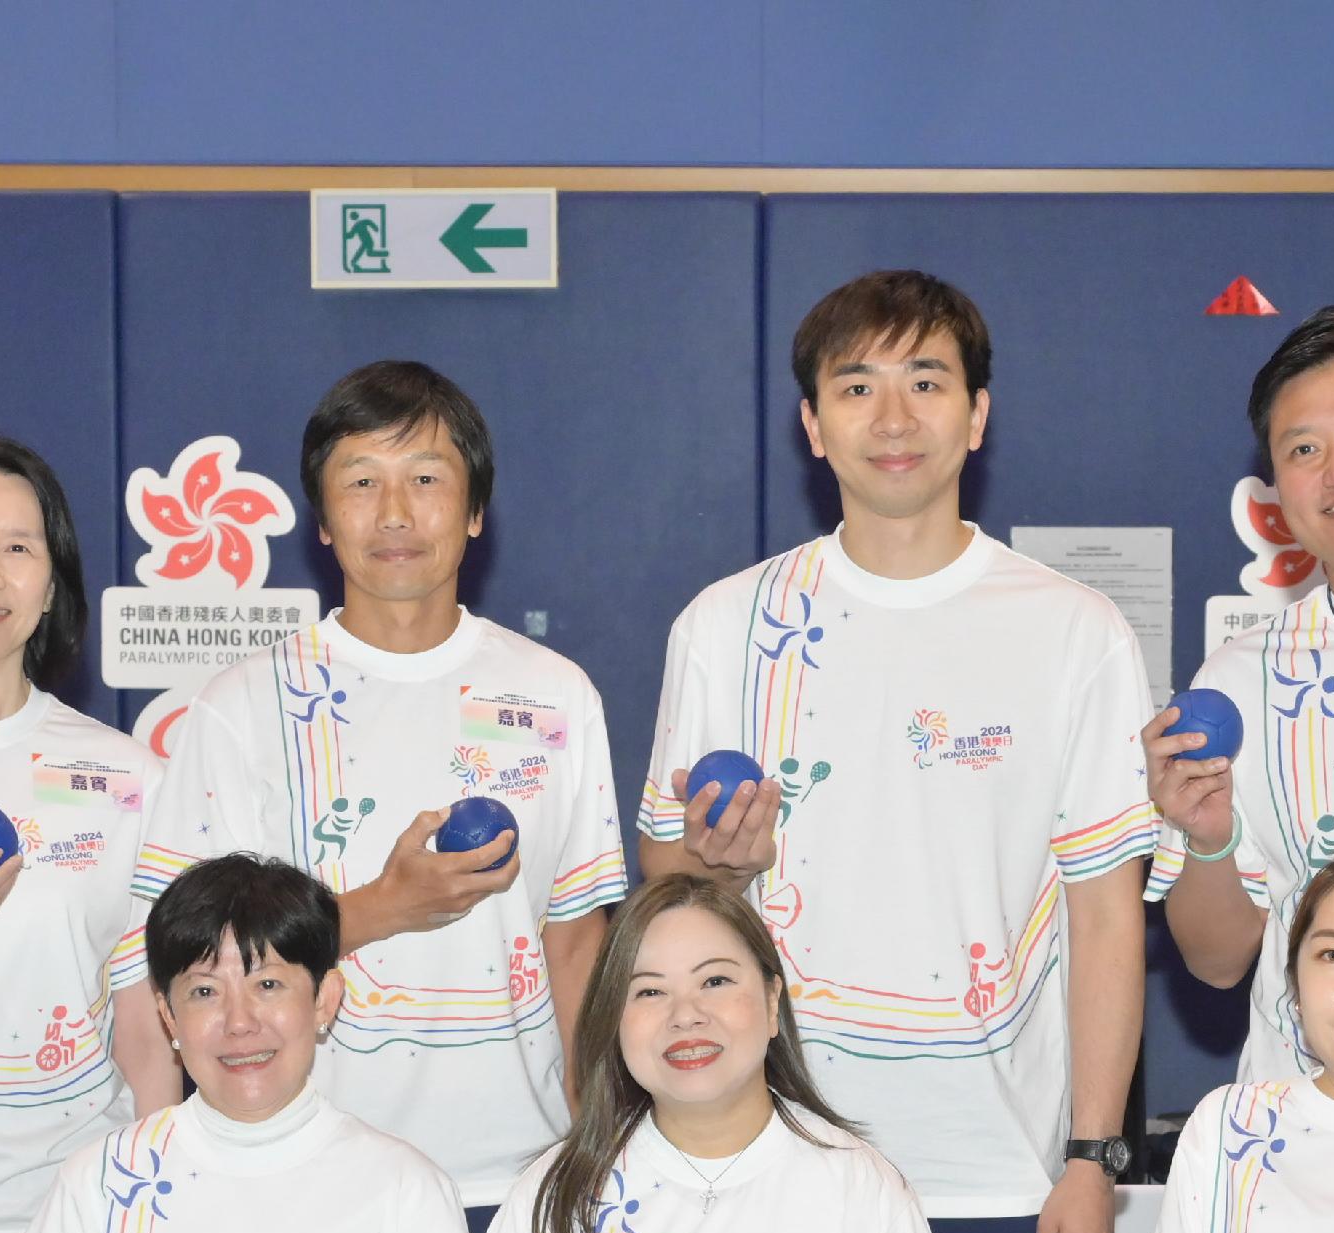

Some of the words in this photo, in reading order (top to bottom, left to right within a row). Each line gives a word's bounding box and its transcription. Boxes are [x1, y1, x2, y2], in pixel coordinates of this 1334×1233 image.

[119, 605, 301, 624] 中國香港殘疾人奧委會
[1224, 613, 1275, 629] 中國
[119, 628, 180, 646] CHINA
[187, 628, 242, 647] HONG
[119, 651, 210, 665] PARALYMPIC
[216, 652, 248, 665] COM
[498, 709, 533, 729] 嘉賓
[980, 725, 1011, 737] 2024
[939, 750, 968, 760] HONG
[969, 748, 997, 757] KONG
[956, 755, 1003, 766] PARALYMPIC
[520, 755, 547, 768] 2024
[70, 774, 107, 793] 嘉賓
[489, 780, 515, 792] HONG
[515, 777, 539, 789] KONG
[74, 831, 103, 842] 2024
[36, 854, 65, 863] HONG
[67, 852, 93, 860] KONG
